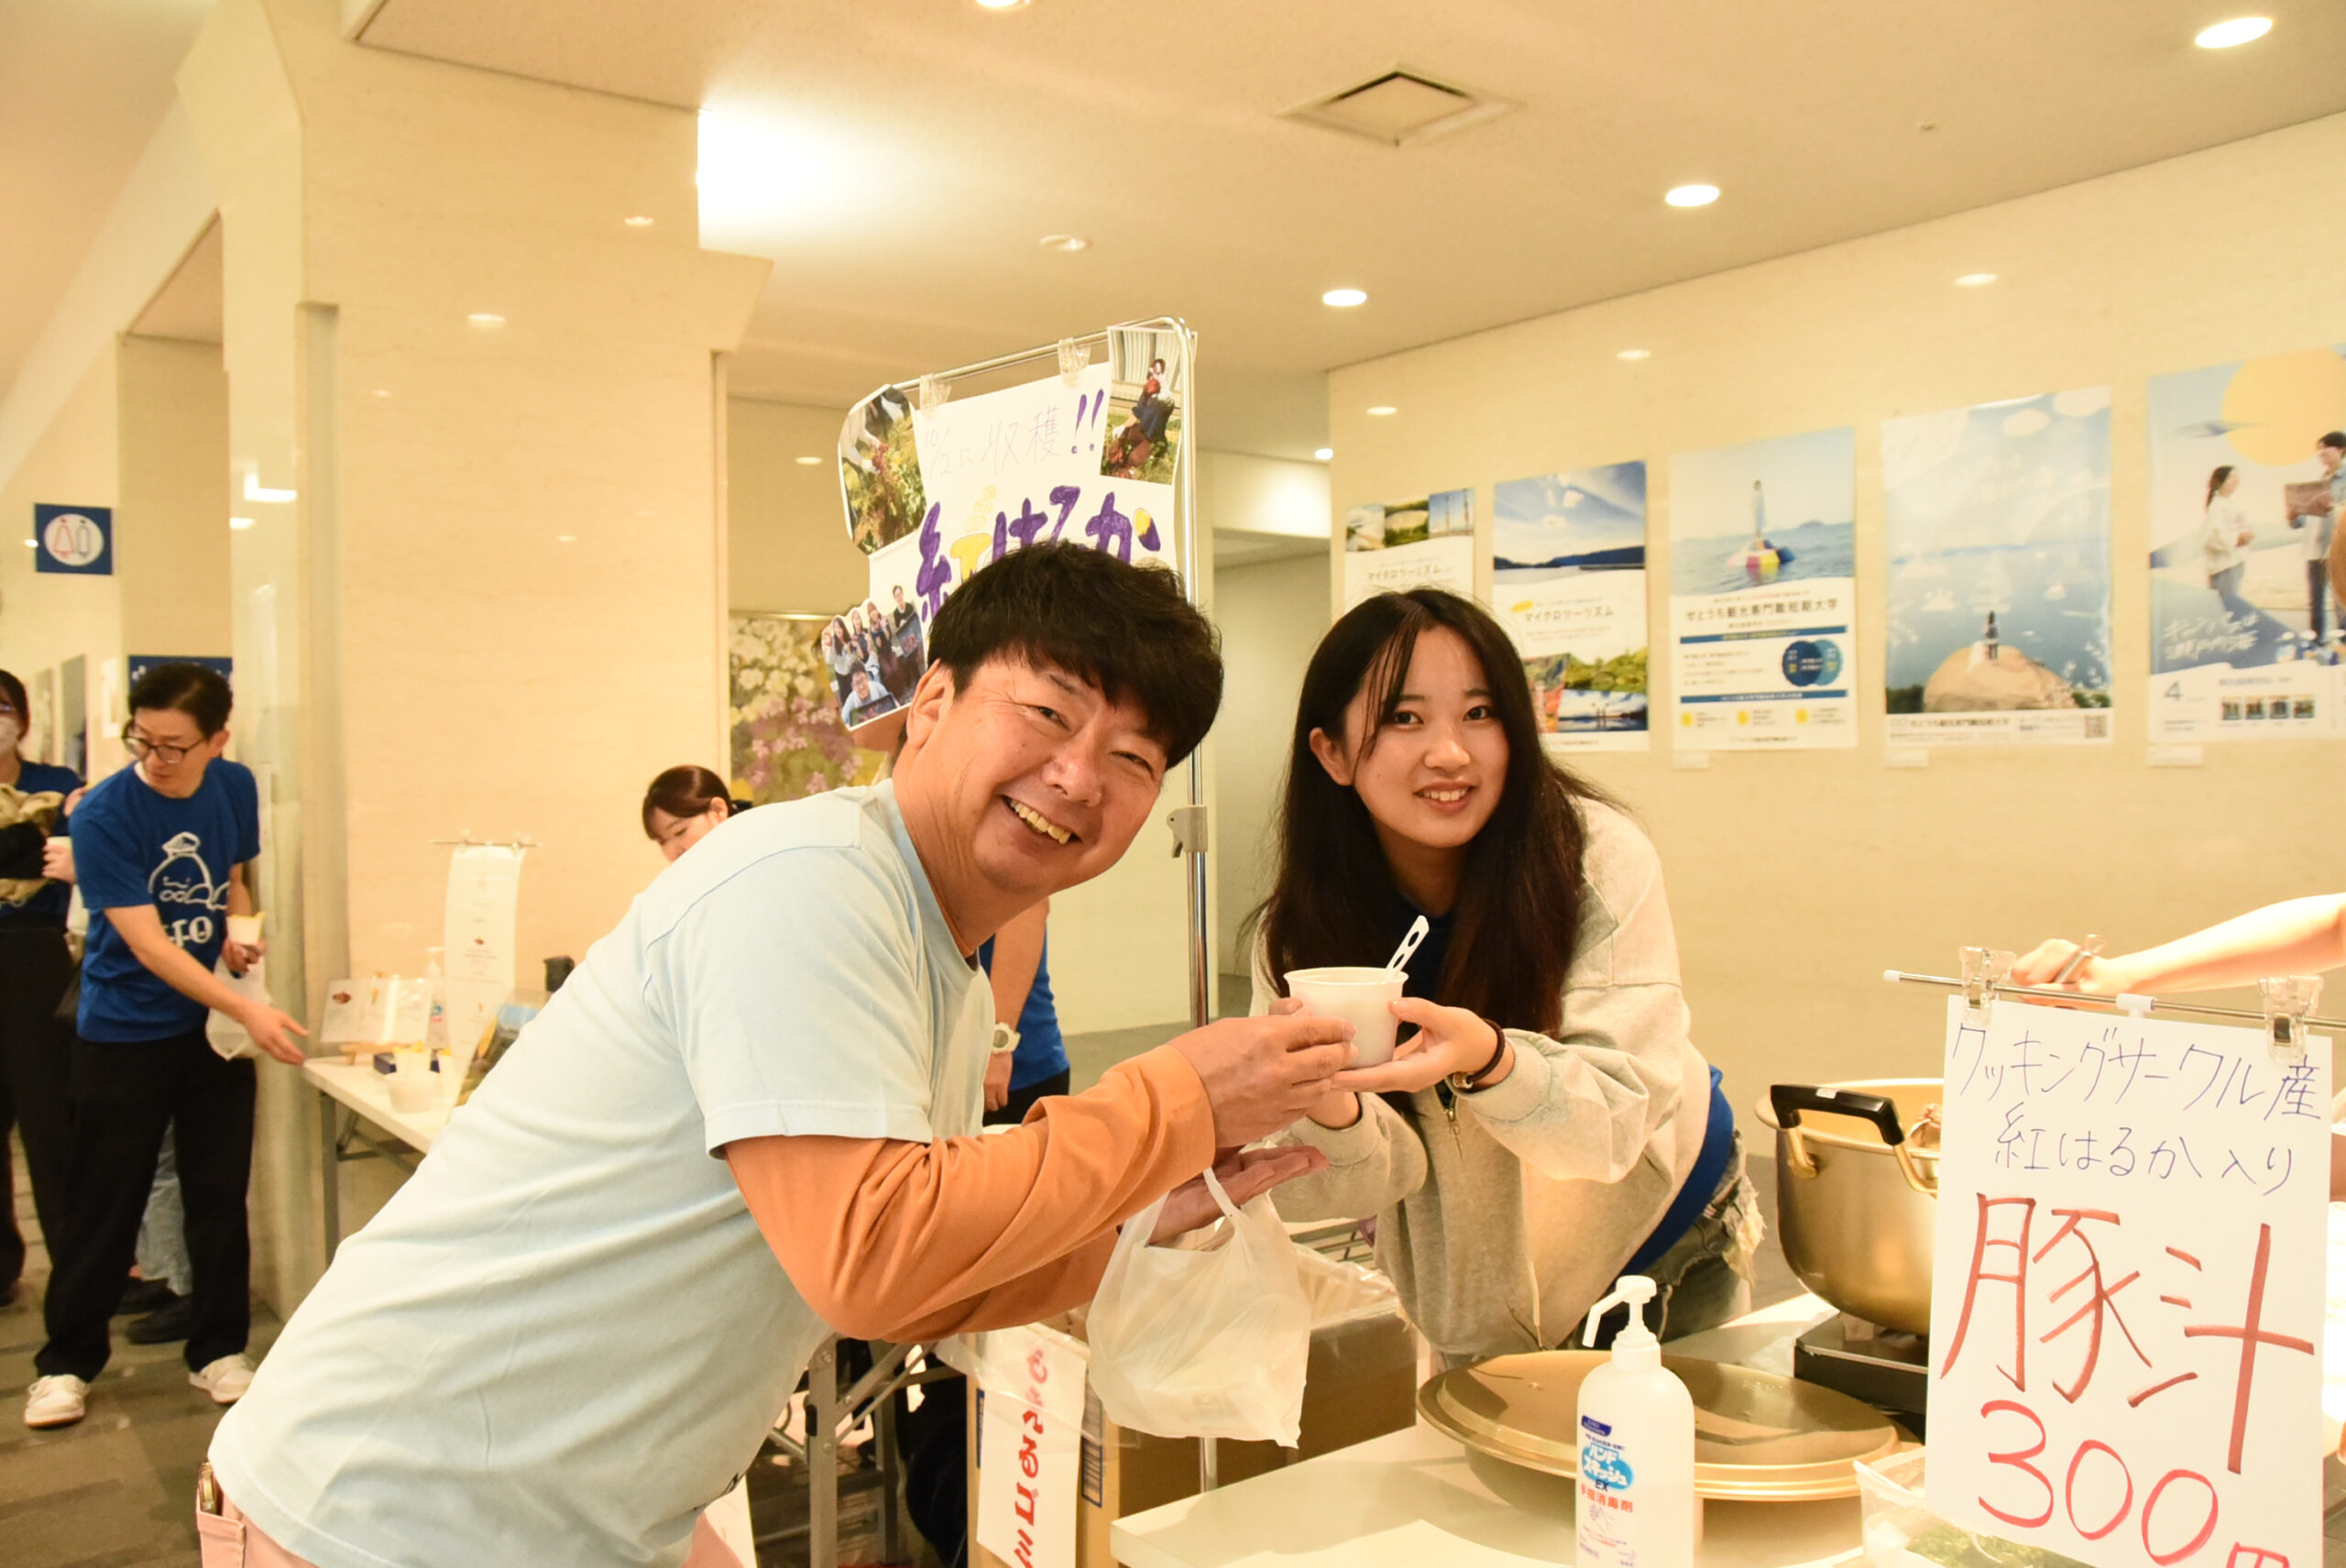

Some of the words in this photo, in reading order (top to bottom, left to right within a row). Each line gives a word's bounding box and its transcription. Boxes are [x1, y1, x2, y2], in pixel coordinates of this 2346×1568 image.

[1953, 1021, 2322, 1122] クッキングサークル産
[1995, 1102, 2293, 1196] 紅はるか入り
[1939, 1192, 2315, 1475] 豚汁
[1595, 1478, 1610, 1492] EX
